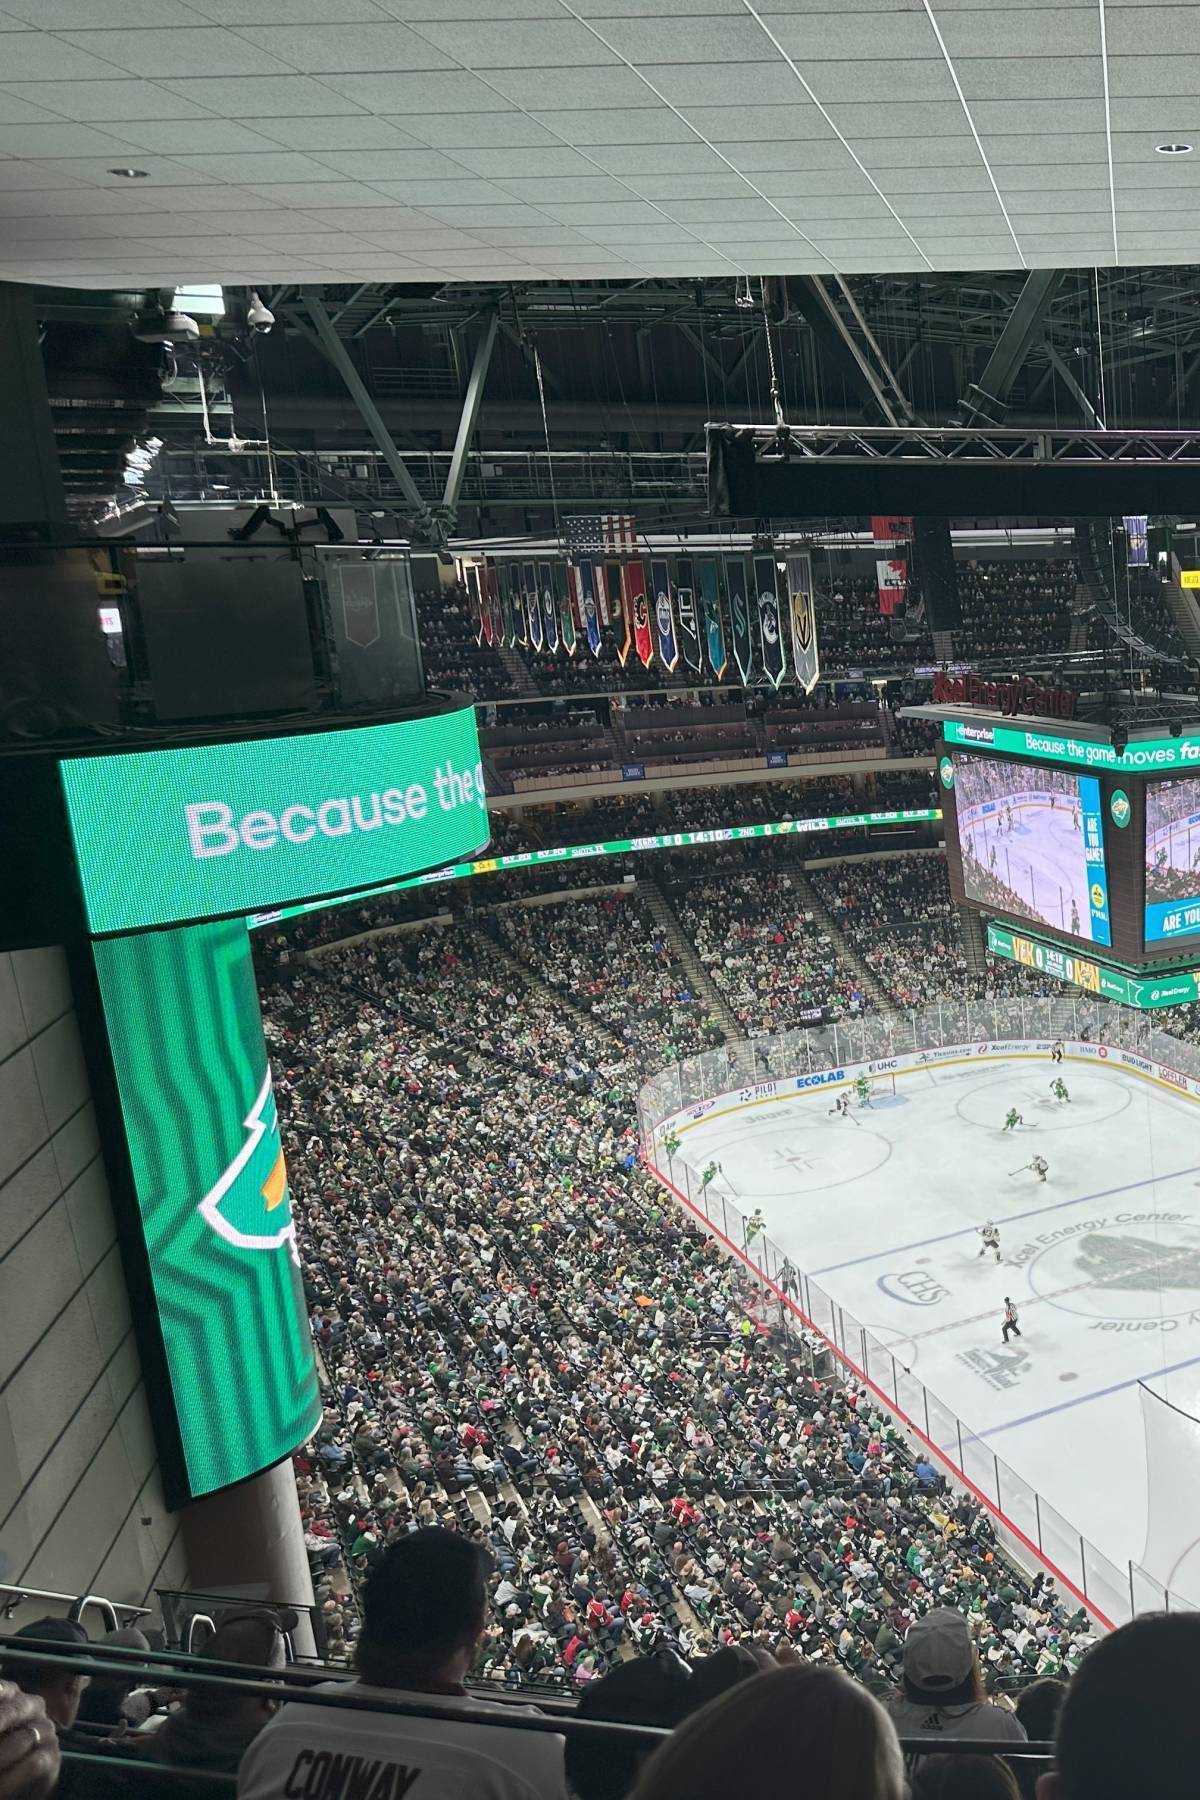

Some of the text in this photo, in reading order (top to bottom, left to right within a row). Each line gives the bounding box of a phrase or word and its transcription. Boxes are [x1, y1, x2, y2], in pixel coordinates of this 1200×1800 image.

[958, 726, 994, 741] enterprise
[1024, 733, 1065, 755] Because
[1067, 739, 1085, 757] the
[1086, 746, 1116, 765] game
[184, 783, 428, 860] Because
[432, 761, 473, 811] the
[796, 821, 828, 833] WILD
[1087, 818, 1098, 832] ARE
[632, 837, 657, 848] VEGAS
[1088, 833, 1099, 847] YOU
[1163, 915, 1181, 932] ARE
[1035, 947, 1043, 969] 0
[1065, 959, 1074, 980] 0
[1080, 1046, 1097, 1055] BMO
[877, 1060, 897, 1071] UHC
[1122, 1054, 1153, 1073] BUD LIGHT
[797, 1071, 845, 1089] ECOLAB
[1158, 1066, 1187, 1088] LOFFLER
[755, 1082, 777, 1096] PILOT
[1004, 1212, 1193, 1269] Xcel Energy Center
[897, 1271, 953, 1302] CHS
[1087, 1319, 1178, 1335] Center
[283, 1749, 424, 1800] CONWAY
